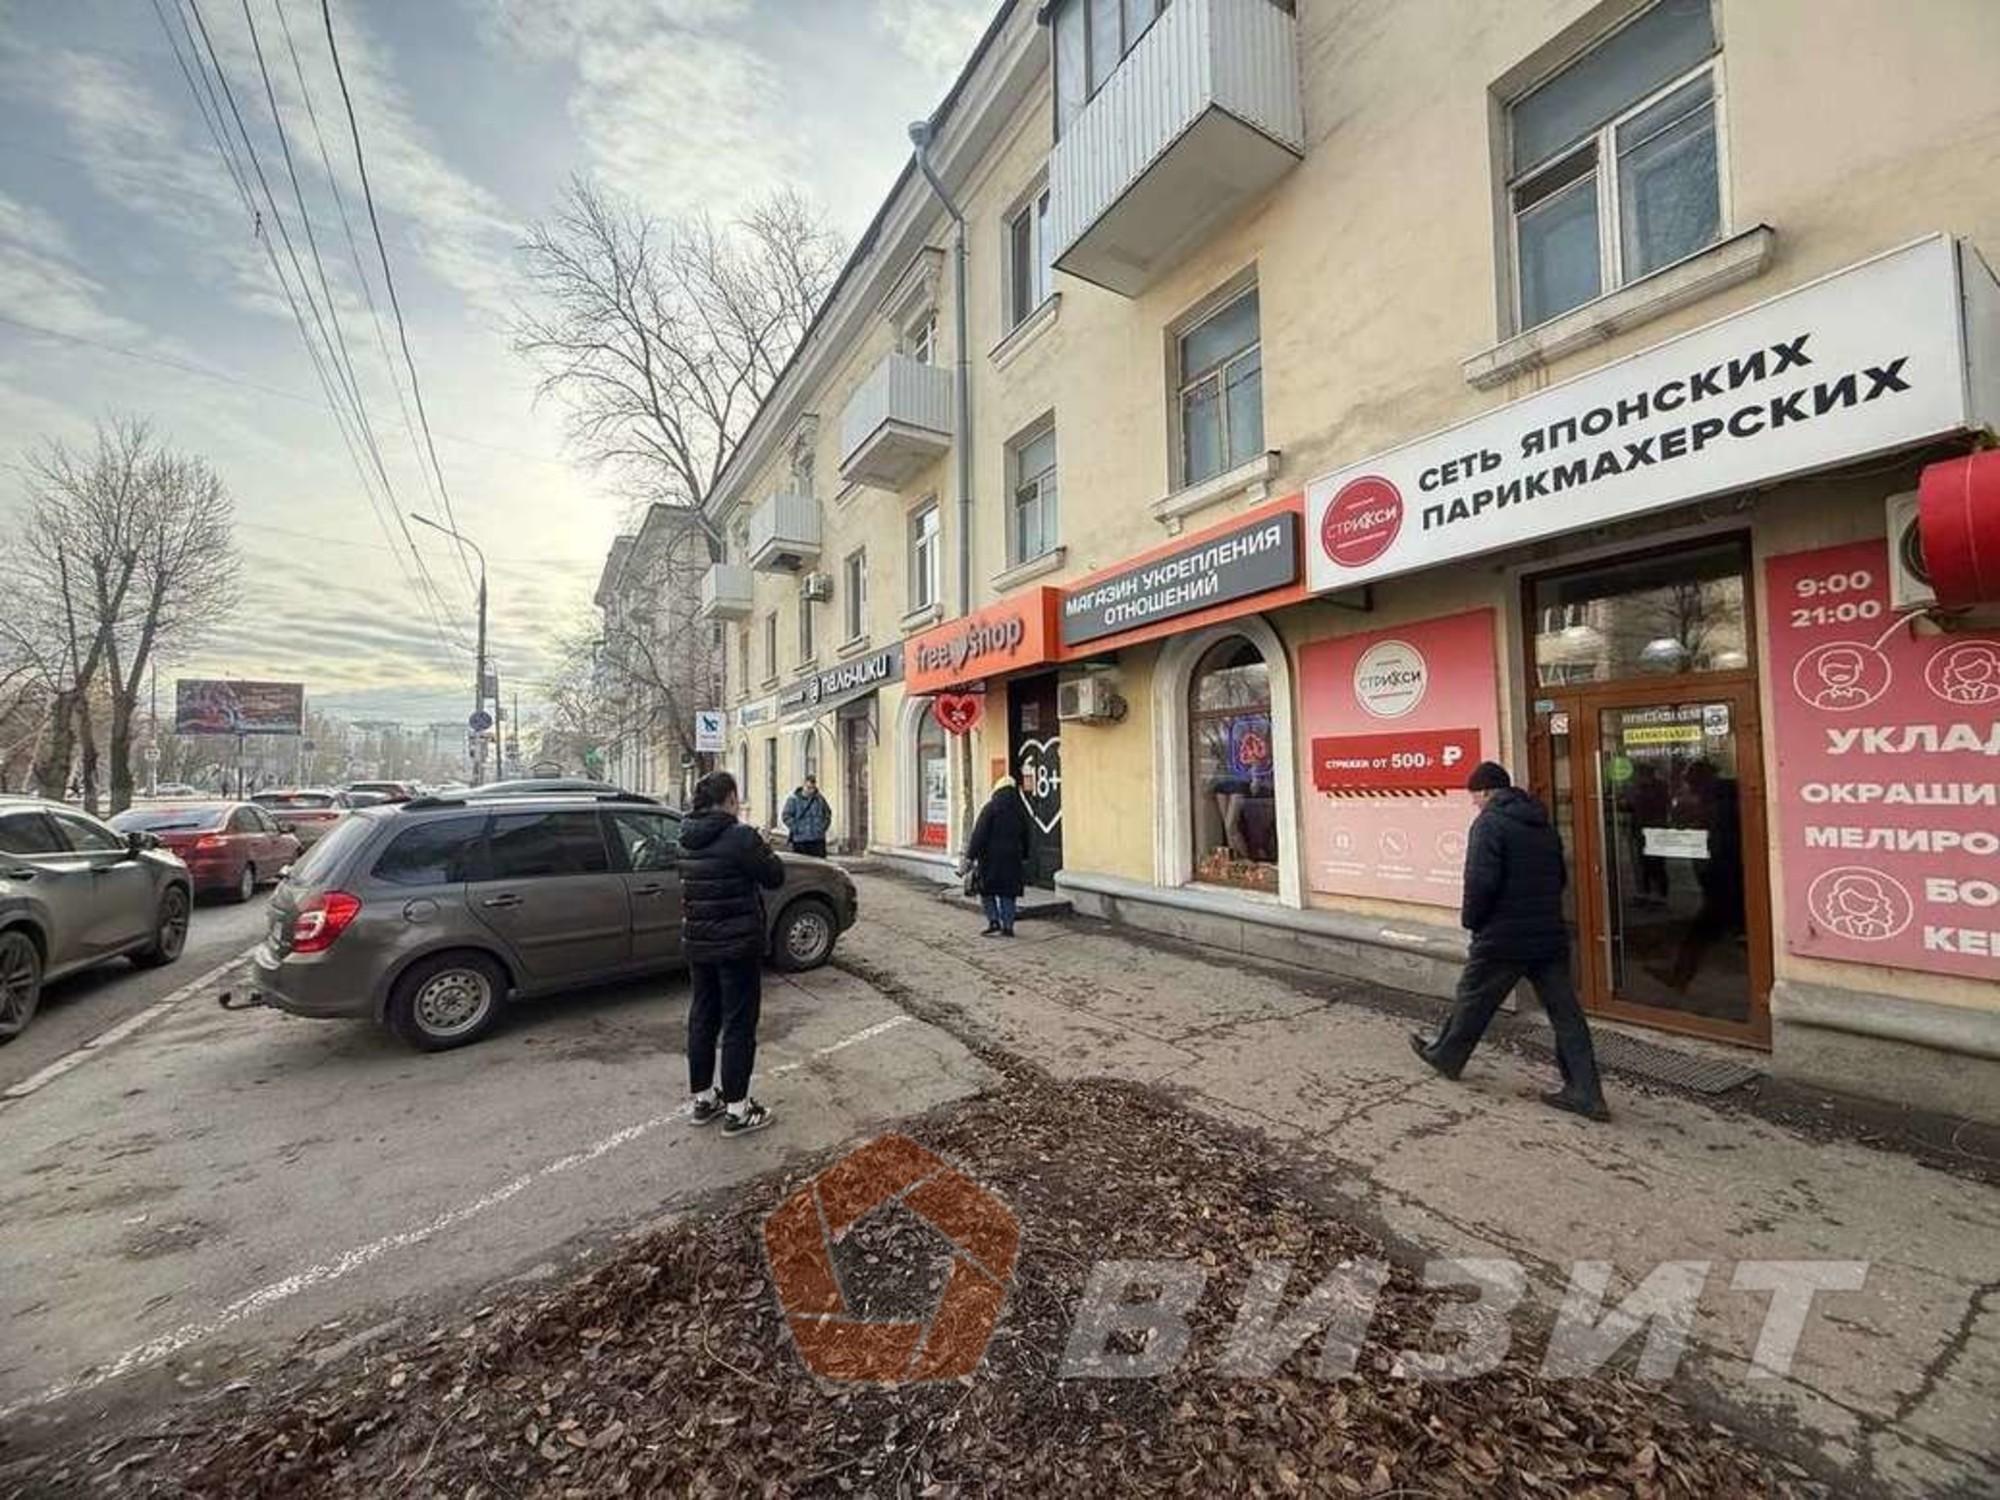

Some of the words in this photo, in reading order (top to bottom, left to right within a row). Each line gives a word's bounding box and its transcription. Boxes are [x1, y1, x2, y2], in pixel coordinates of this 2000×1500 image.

[1417, 448, 1502, 493] СЕТЬ
[1520, 332, 1813, 458] ЯПОНСКИХ
[1421, 356, 1912, 531] ПАРИКМАХЕРСКИХ
[1065, 578, 1138, 616] МАГАЗИН
[1142, 523, 1282, 590] УКРЕПЛЕНИЯ
[1796, 570, 1873, 598] 9:00
[1103, 570, 1220, 626] ОТНОШЕНИЙ
[1791, 600, 1882, 629] 21:00
[1372, 758, 1388, 768] ОТ
[1391, 752, 1425, 768] 500
[1801, 783, 1997, 806] ОКРАШИ
[1804, 826, 2000, 855] МЕЛИРО
[1925, 878, 2000, 907] БО
[1924, 926, 2000, 957] КЕ
